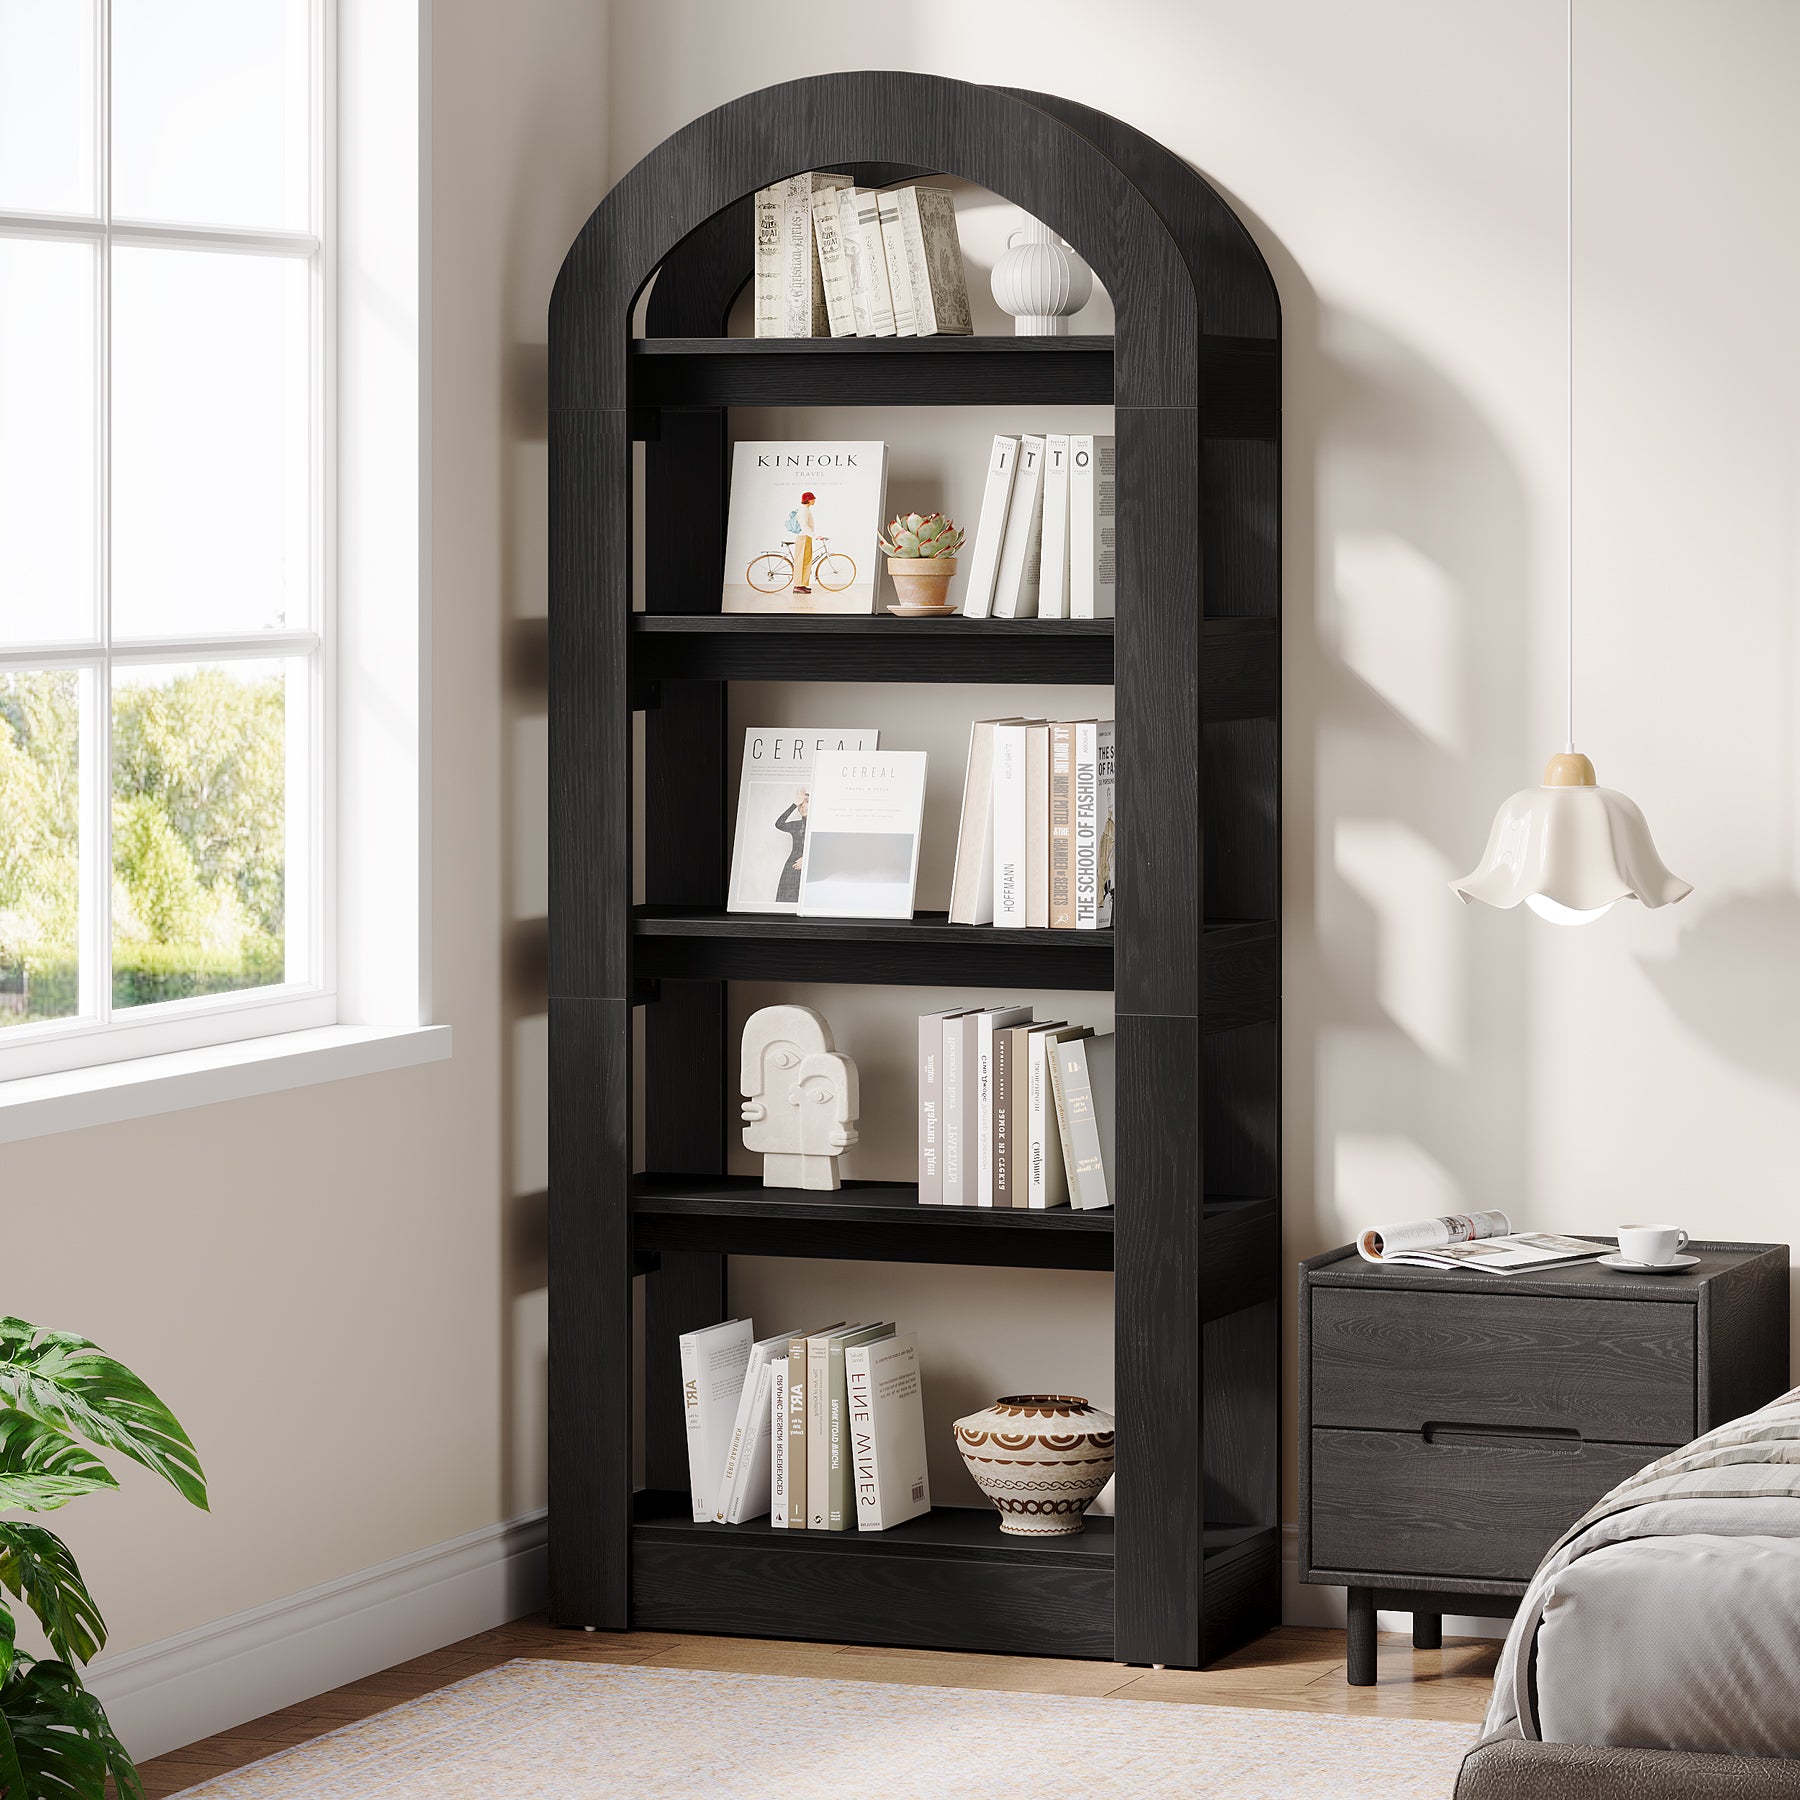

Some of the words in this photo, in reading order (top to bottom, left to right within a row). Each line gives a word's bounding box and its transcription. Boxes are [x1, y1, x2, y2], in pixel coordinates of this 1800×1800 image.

[758, 454, 858, 467] KINFOLK
[1027, 452, 1036, 468] T
[1053, 451, 1062, 467] T
[1075, 451, 1089, 467] O
[1053, 727, 1070, 742] J.K.
[1053, 742, 1070, 774] ROWLING
[1098, 746, 1109, 760] THE
[841, 766, 896, 778] CEREAL
[1098, 762, 1106, 776] OF
[1107, 761, 1115, 775] FA
[1053, 775, 1069, 799] HARRY
[1077, 763, 1094, 817] FASHION
[1053, 800, 1069, 825] POTTER
[1077, 822, 1094, 839] OF
[1053, 838, 1069, 870] CHAMBER
[1077, 841, 1094, 894] SCHOOL
[1003, 863, 1015, 912] HOFFMANN
[1053, 876, 1069, 906] SECRETS
[1077, 898, 1094, 921] THE
